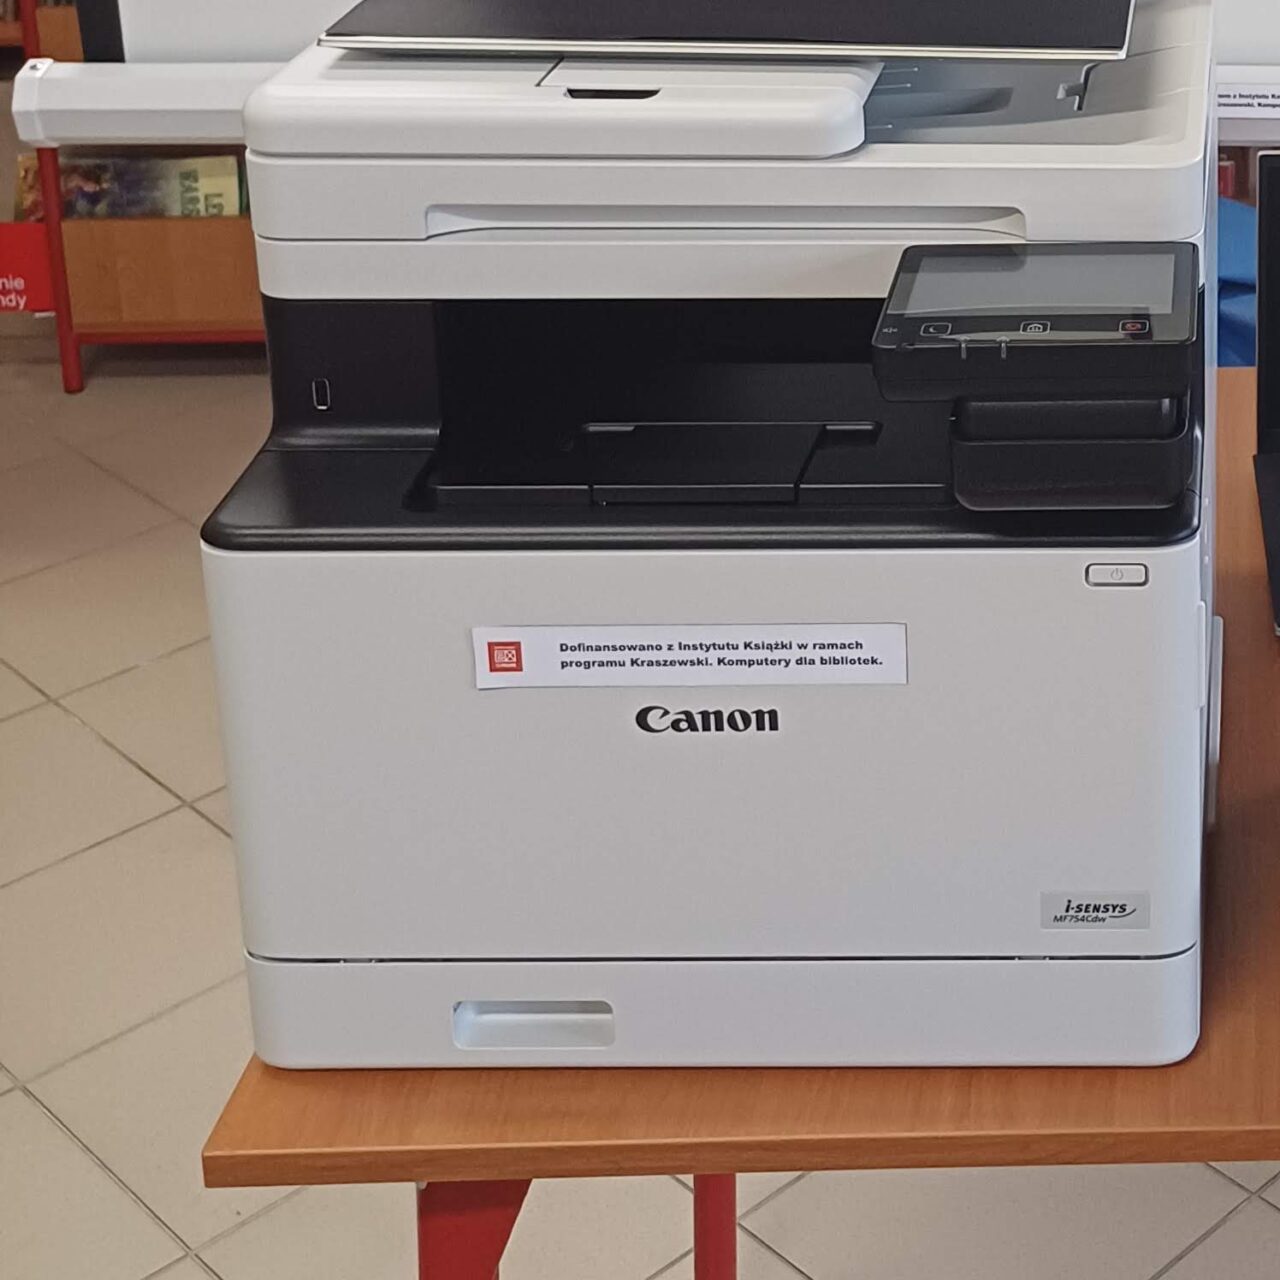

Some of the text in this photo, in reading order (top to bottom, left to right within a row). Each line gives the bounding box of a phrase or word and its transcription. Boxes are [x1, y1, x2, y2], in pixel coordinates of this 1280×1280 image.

[560, 640, 863, 653] Dofinansowano z Instytutu Książki w ramach
[560, 656, 883, 670] programu Kraszewski. Komputery dla bibliotek.
[635, 705, 779, 733] Canon
[1064, 899, 1128, 914] i-SENSYS
[1053, 914, 1107, 924] MF754Cdw
